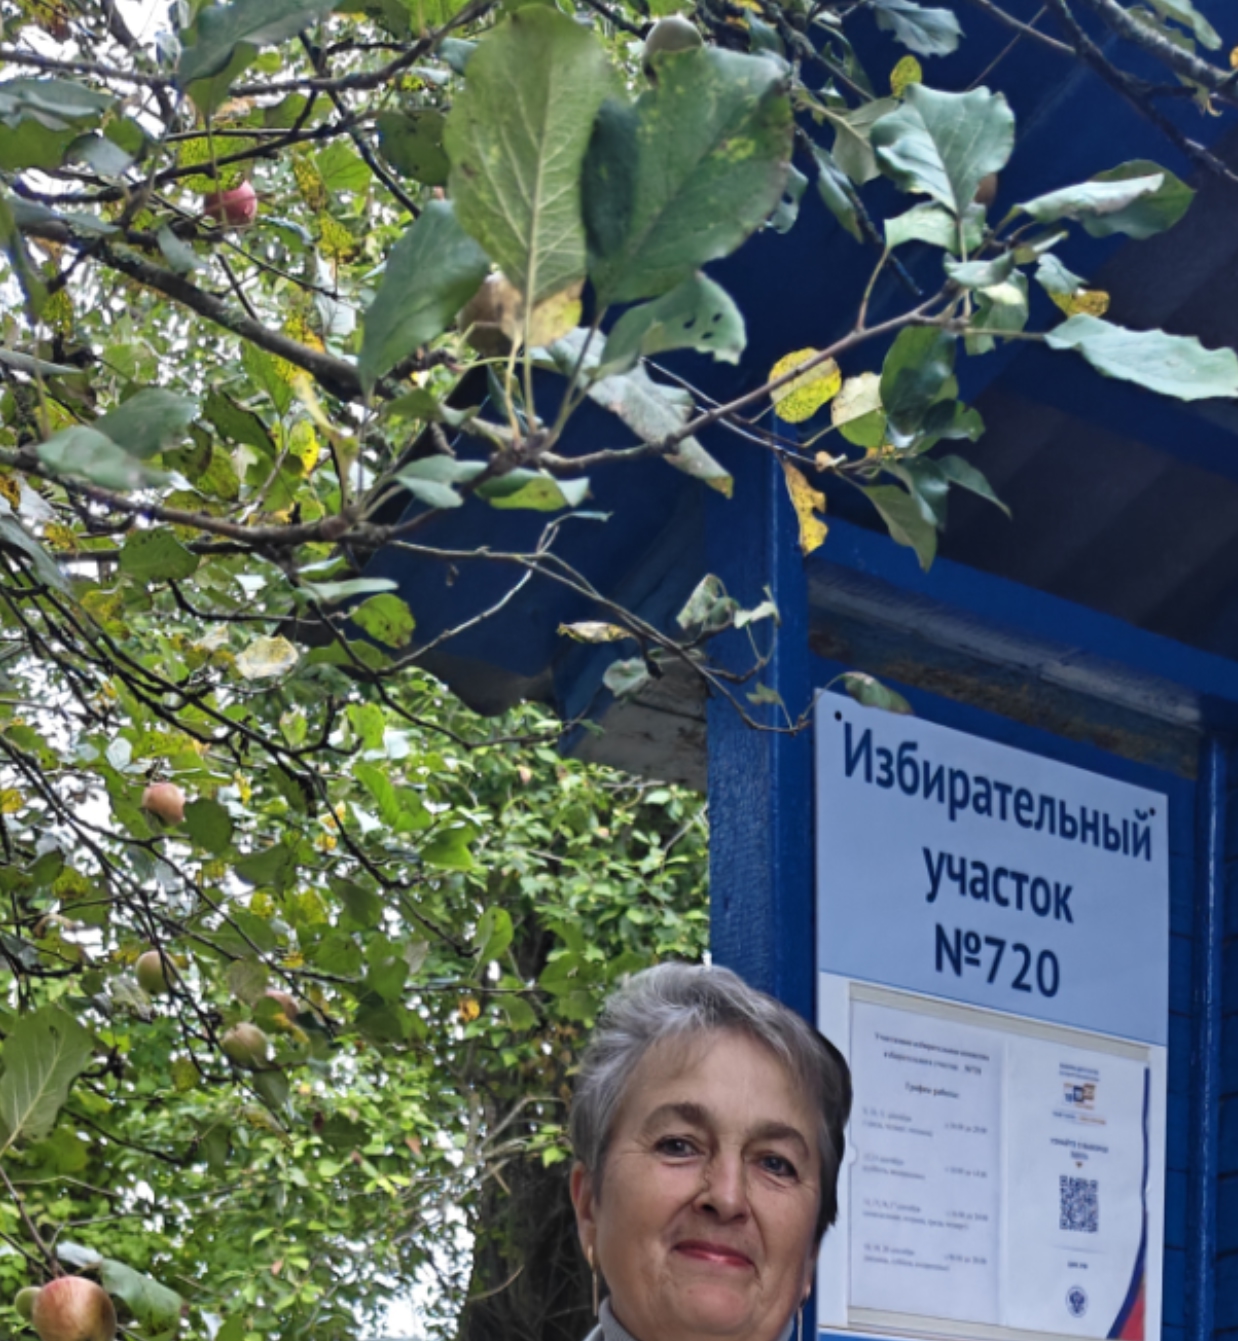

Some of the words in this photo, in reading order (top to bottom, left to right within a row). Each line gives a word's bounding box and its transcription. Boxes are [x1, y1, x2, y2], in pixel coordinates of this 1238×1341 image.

[843, 721, 1152, 862] Избирательный
[922, 846, 1074, 924] участок
[934, 922, 1061, 998] №720
